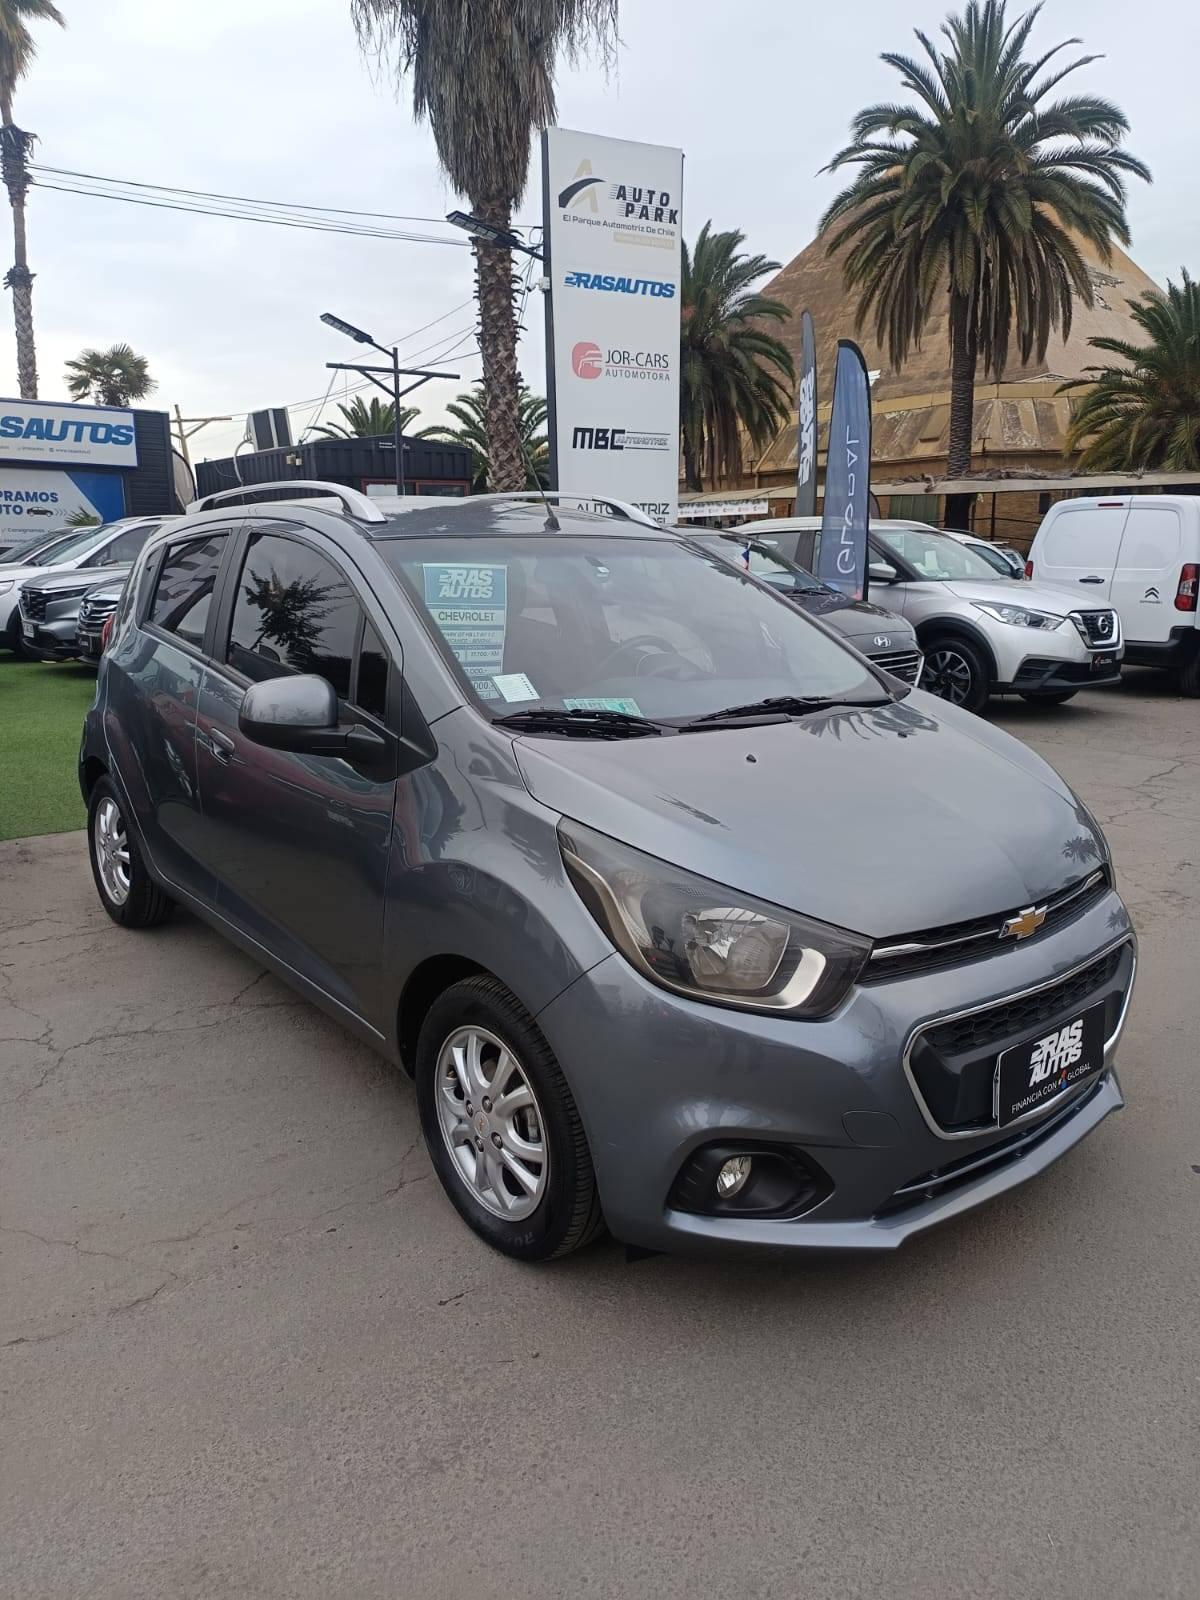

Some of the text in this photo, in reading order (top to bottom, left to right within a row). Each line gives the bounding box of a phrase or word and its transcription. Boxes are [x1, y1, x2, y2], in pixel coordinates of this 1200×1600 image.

[615, 184, 671, 207] AUTO
[625, 202, 679, 225] PARK
[562, 214, 675, 237] El Parque Automotriz De Chile
[567, 271, 676, 299] RASAUTOS
[605, 350, 669, 369] JOR-CARS
[605, 369, 670, 382] AUTOMOTORA
[0, 415, 134, 446] SAUTOS
[572, 427, 625, 451] MBC
[439, 568, 493, 587] RAS
[439, 585, 493, 599] AUTOS
[438, 611, 497, 622] CHEVROLET
[1030, 1019, 1084, 1065] RAS
[1028, 1041, 1083, 1087] AUTOS
[1011, 1062, 1092, 1114] FINANCIA CON GLOBAL
